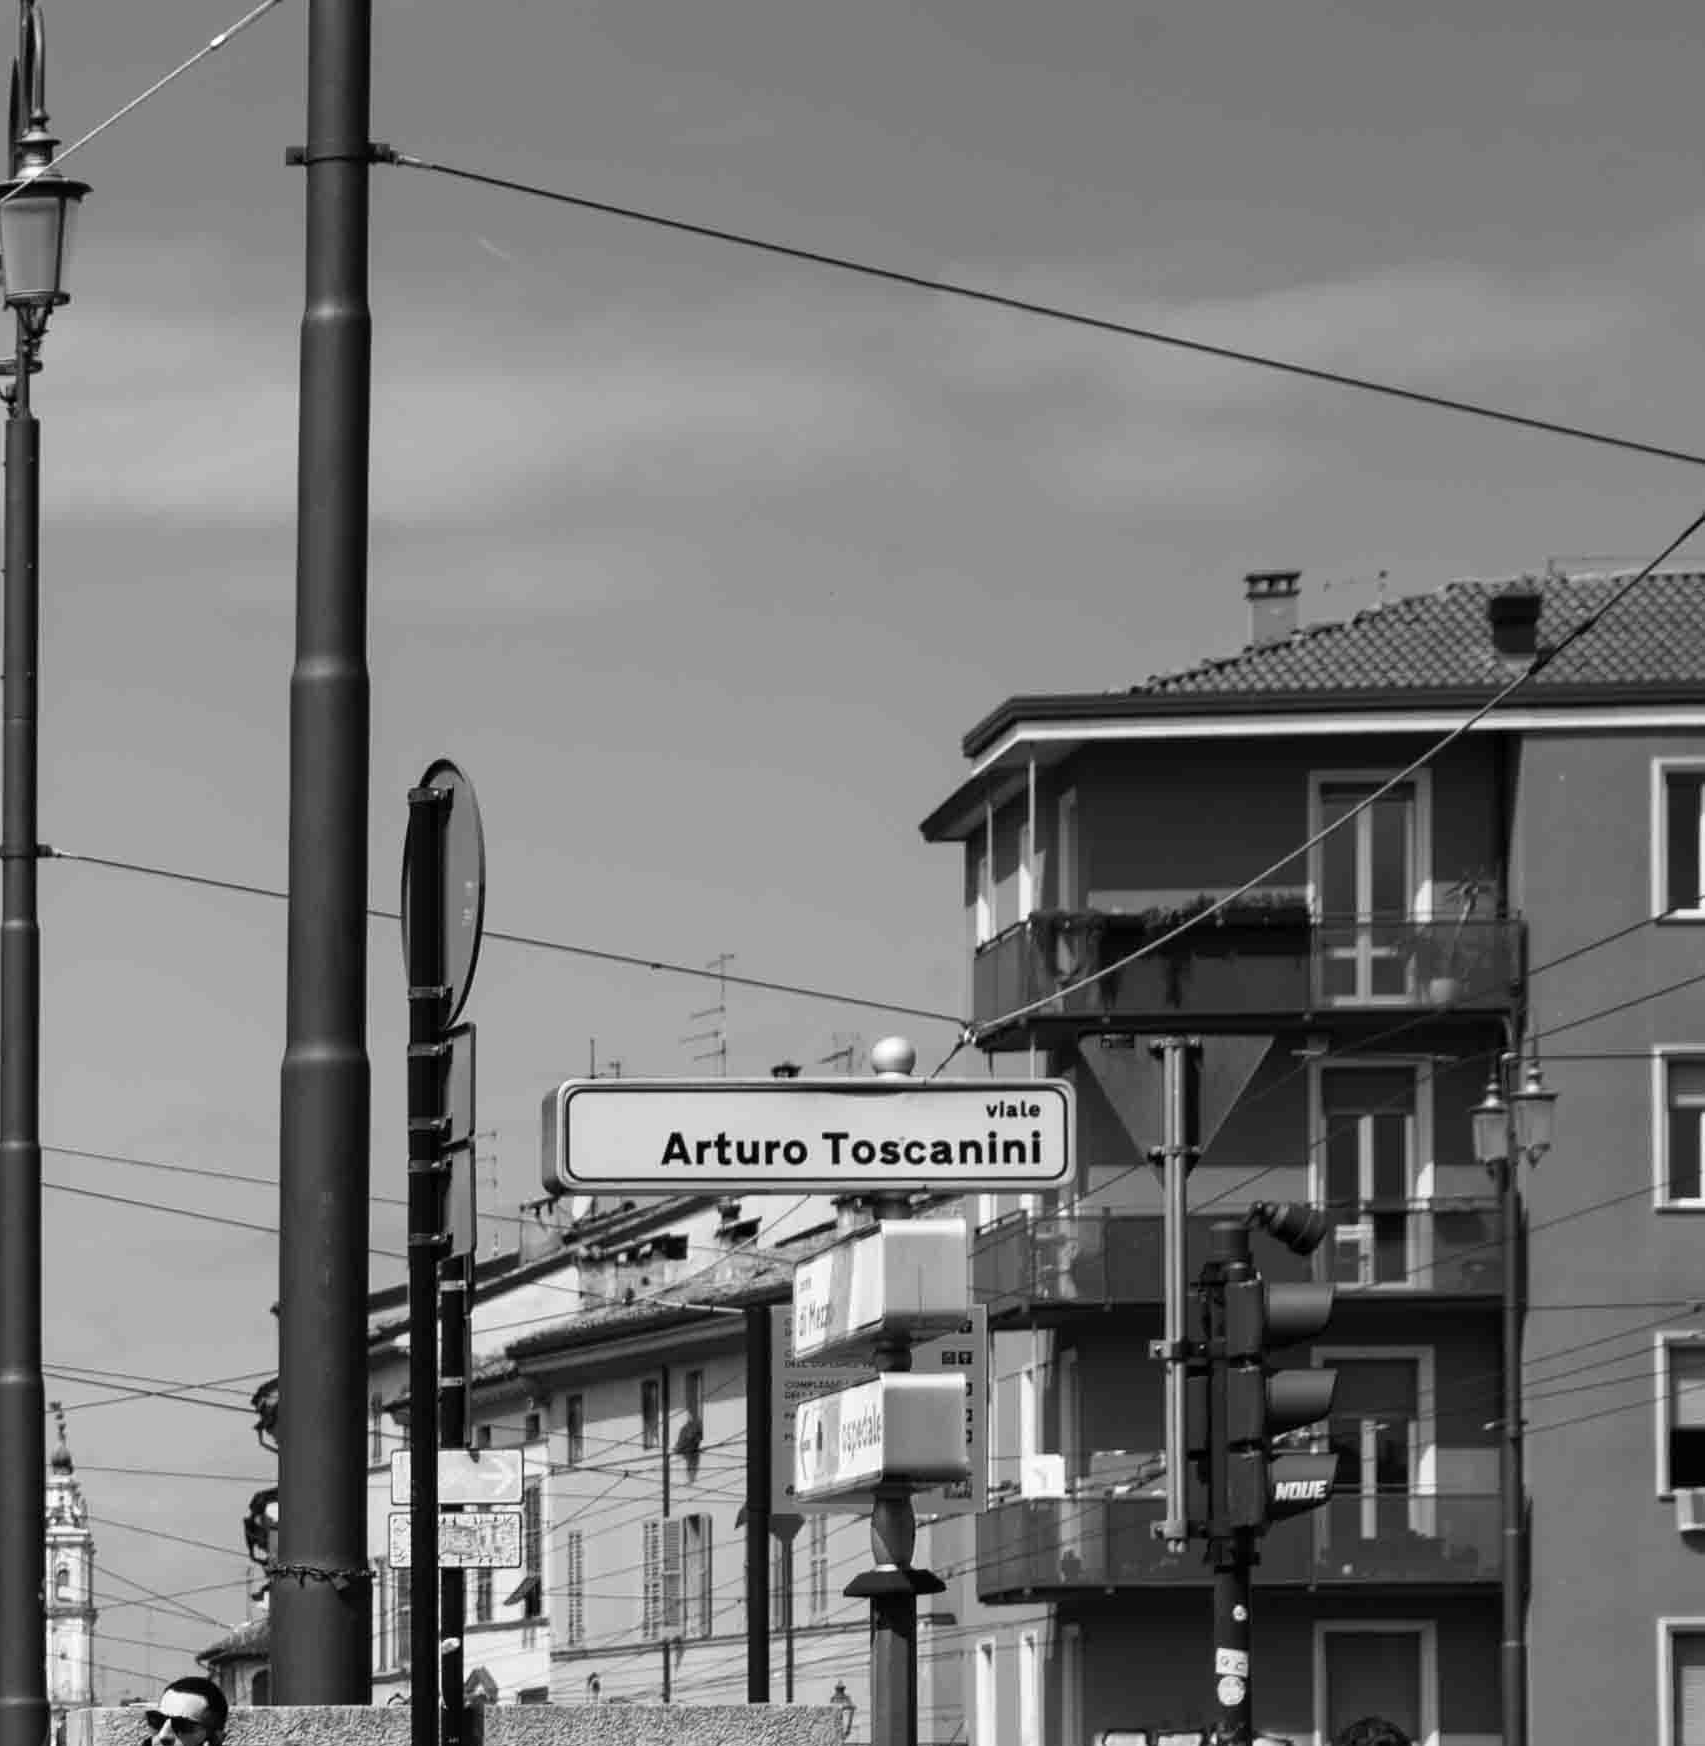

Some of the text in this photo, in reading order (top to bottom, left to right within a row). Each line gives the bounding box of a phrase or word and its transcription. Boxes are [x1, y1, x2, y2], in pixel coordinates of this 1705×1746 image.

[986, 1101, 1041, 1118] viale
[662, 1130, 1041, 1166] Arturo Toscanini
